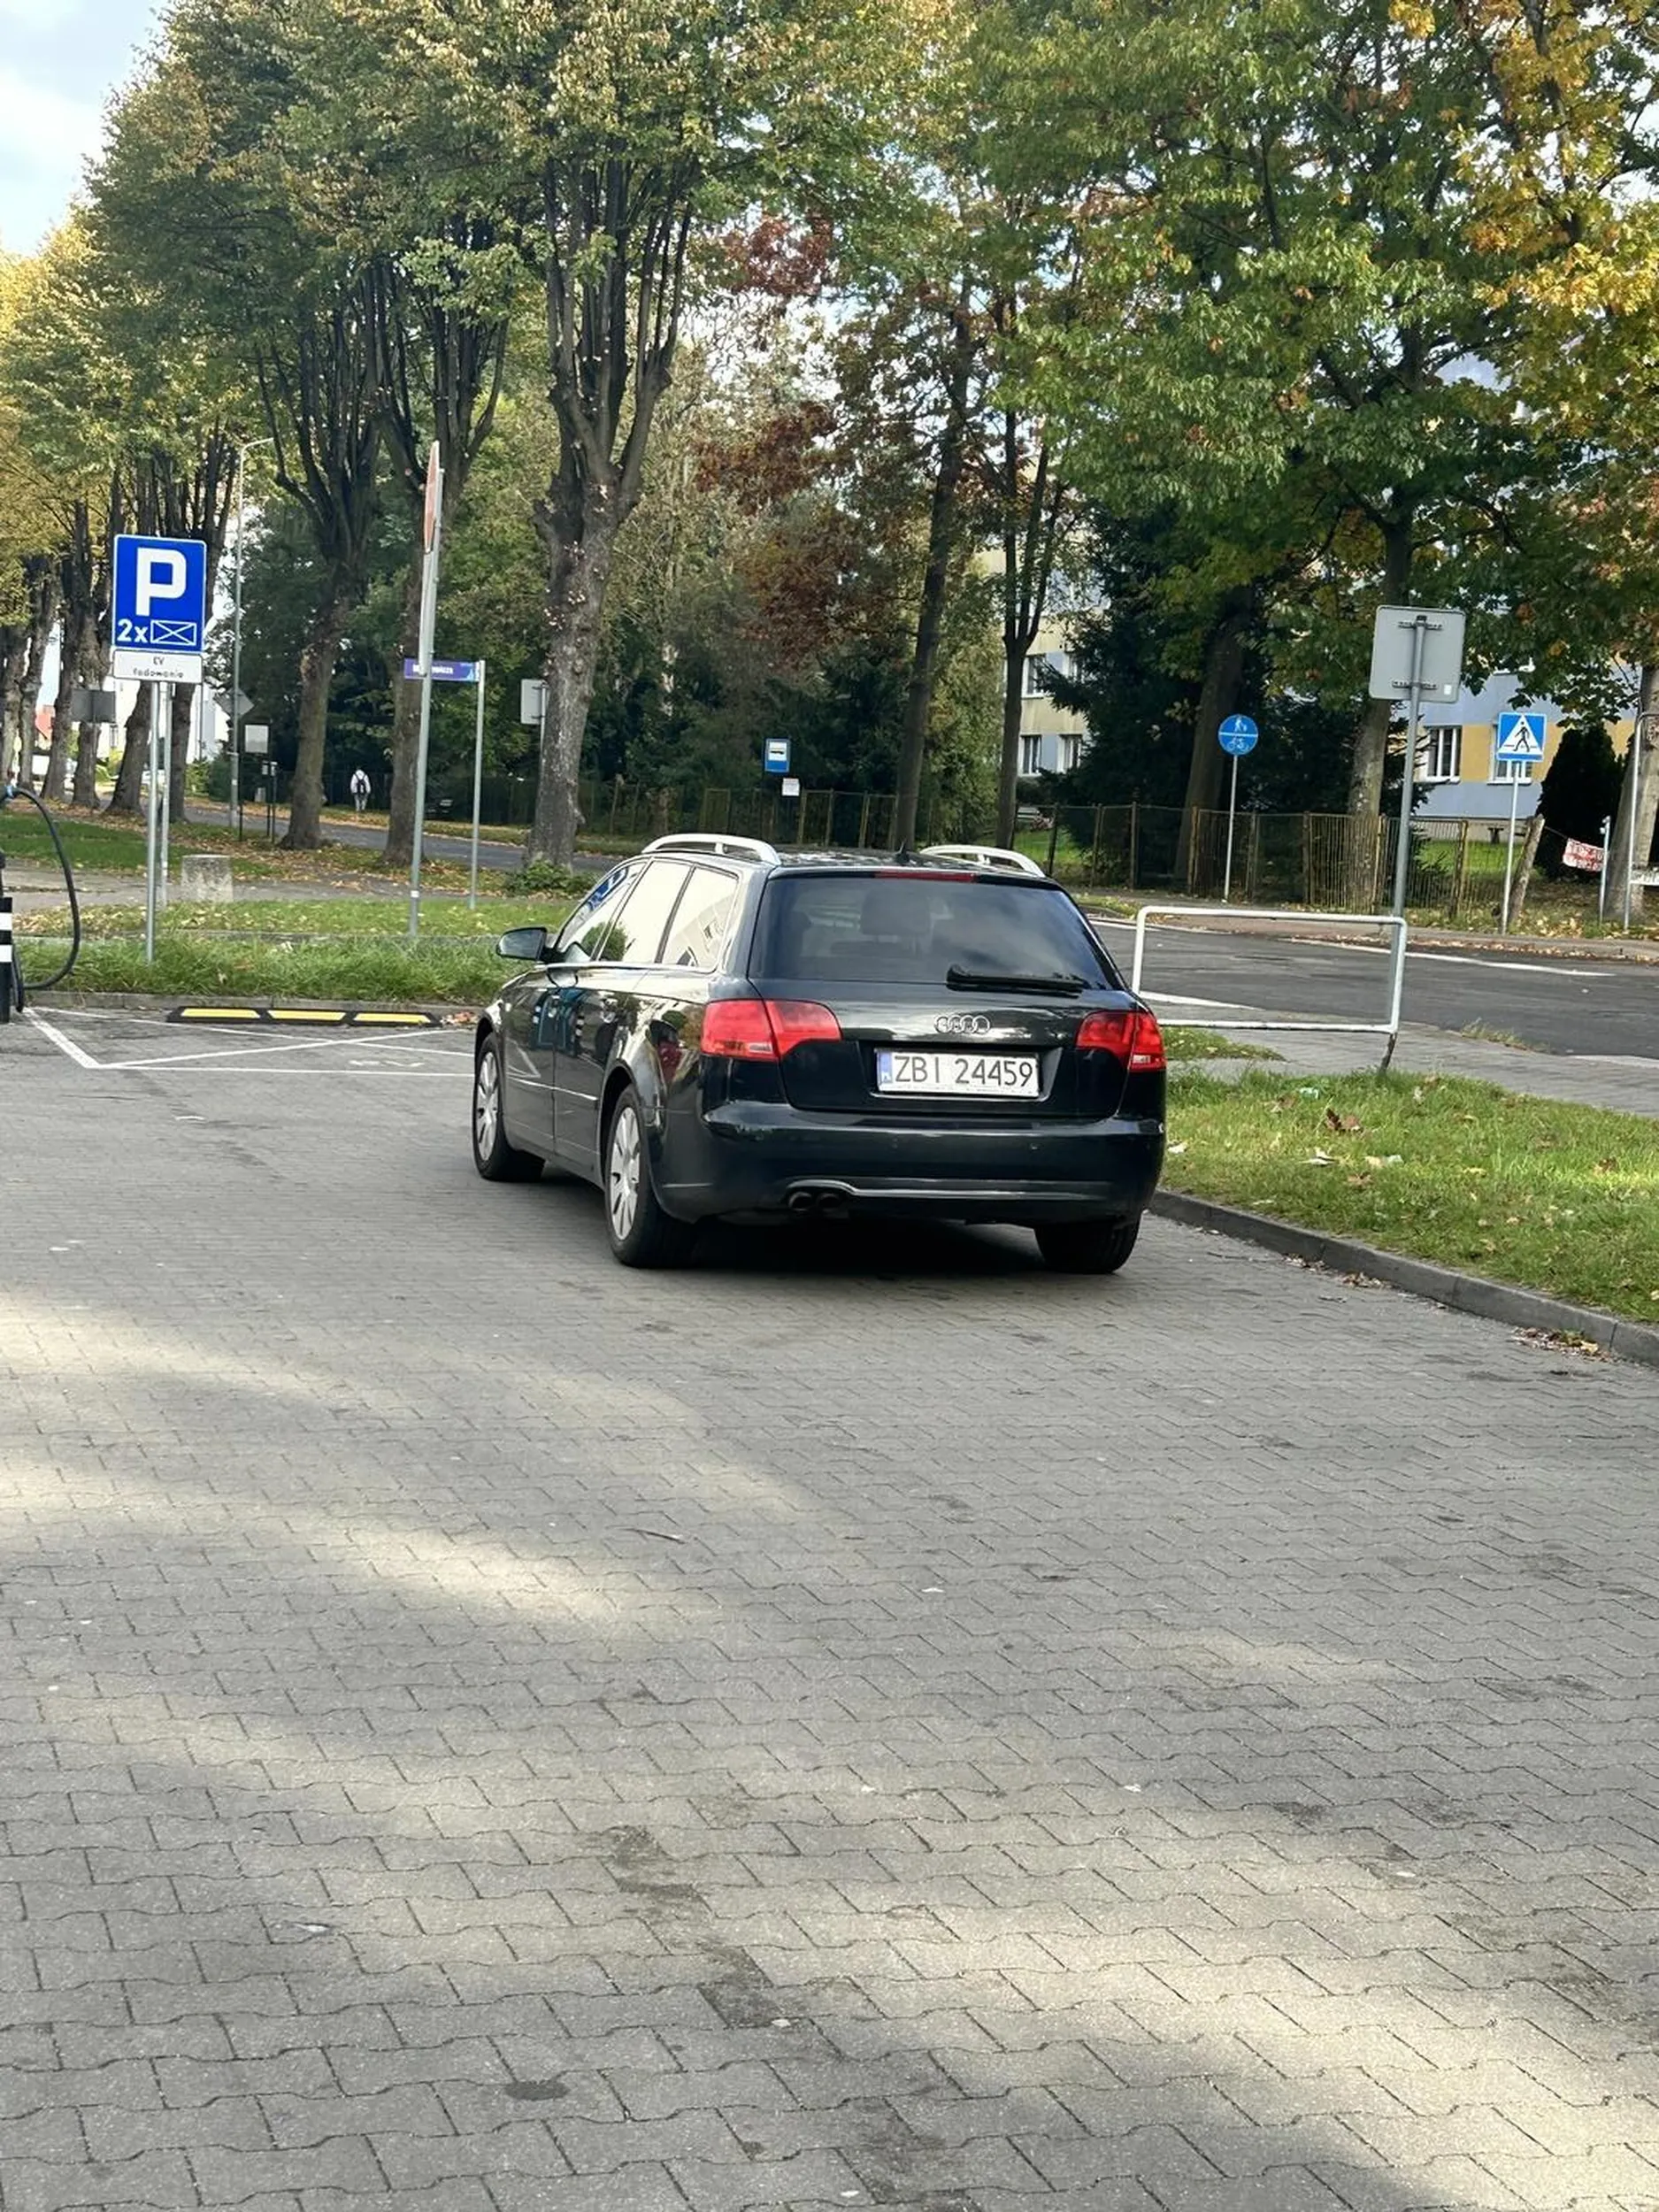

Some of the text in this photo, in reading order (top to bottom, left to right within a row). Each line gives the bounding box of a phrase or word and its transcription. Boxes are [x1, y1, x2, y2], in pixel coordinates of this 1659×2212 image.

[135, 547, 187, 617] P
[117, 618, 149, 643] 2x
[894, 1056, 940, 1083] ZBI
[955, 1058, 1033, 1087] 24459
